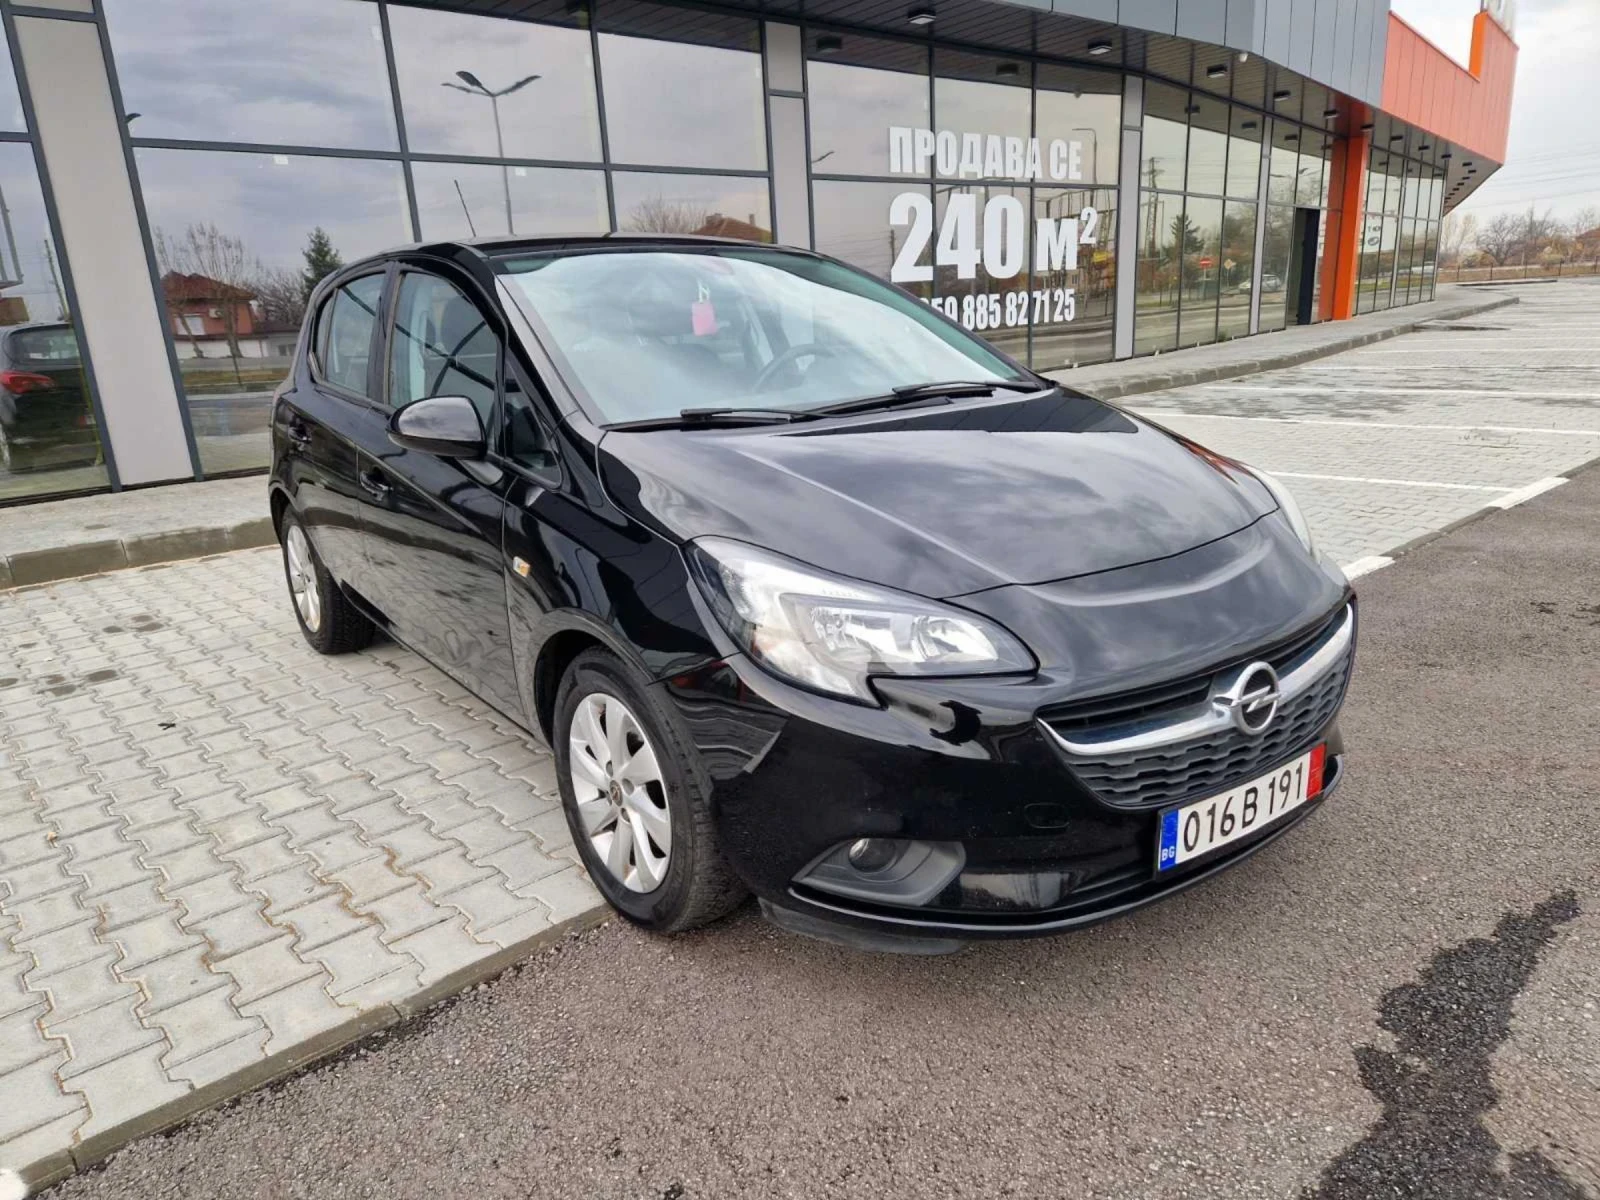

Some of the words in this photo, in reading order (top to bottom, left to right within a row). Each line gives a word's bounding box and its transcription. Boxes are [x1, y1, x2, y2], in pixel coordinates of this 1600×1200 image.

[889, 126, 1042, 179] ПРОДАВА
[1049, 139, 1082, 180] СЕ
[889, 192, 1025, 282] 240
[962, 294, 1001, 331] 885
[1161, 845, 1175, 861] BG
